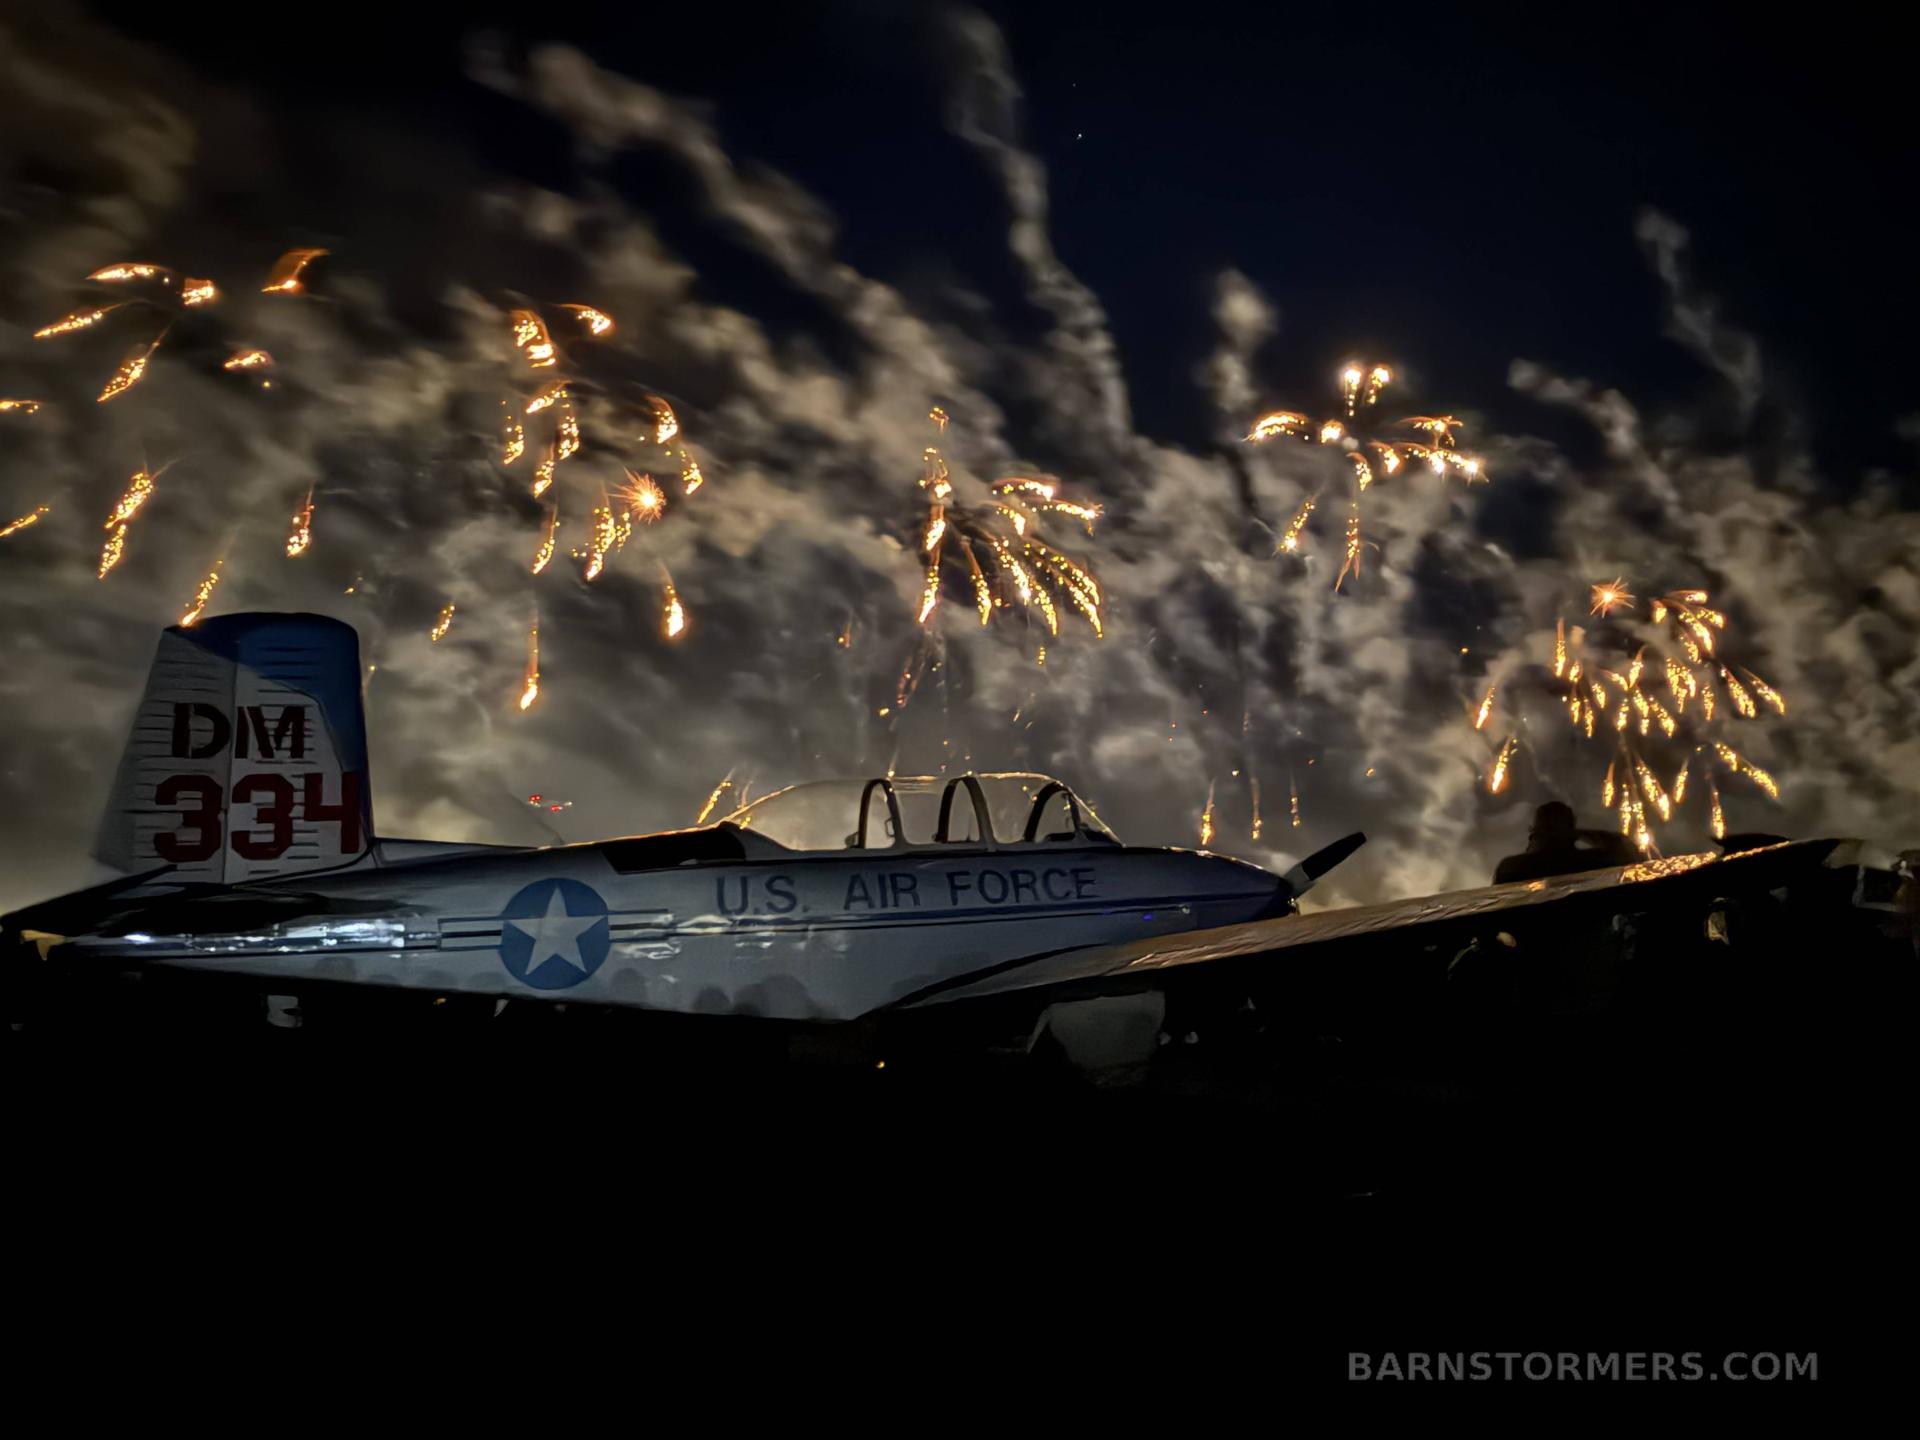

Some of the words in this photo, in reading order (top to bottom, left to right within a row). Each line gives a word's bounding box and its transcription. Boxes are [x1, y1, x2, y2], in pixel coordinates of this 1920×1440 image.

[171, 702, 306, 760] DM
[153, 771, 361, 862] 334
[715, 875, 810, 916] U.S.
[843, 872, 921, 911] AIR
[946, 867, 1100, 906] FORCE
